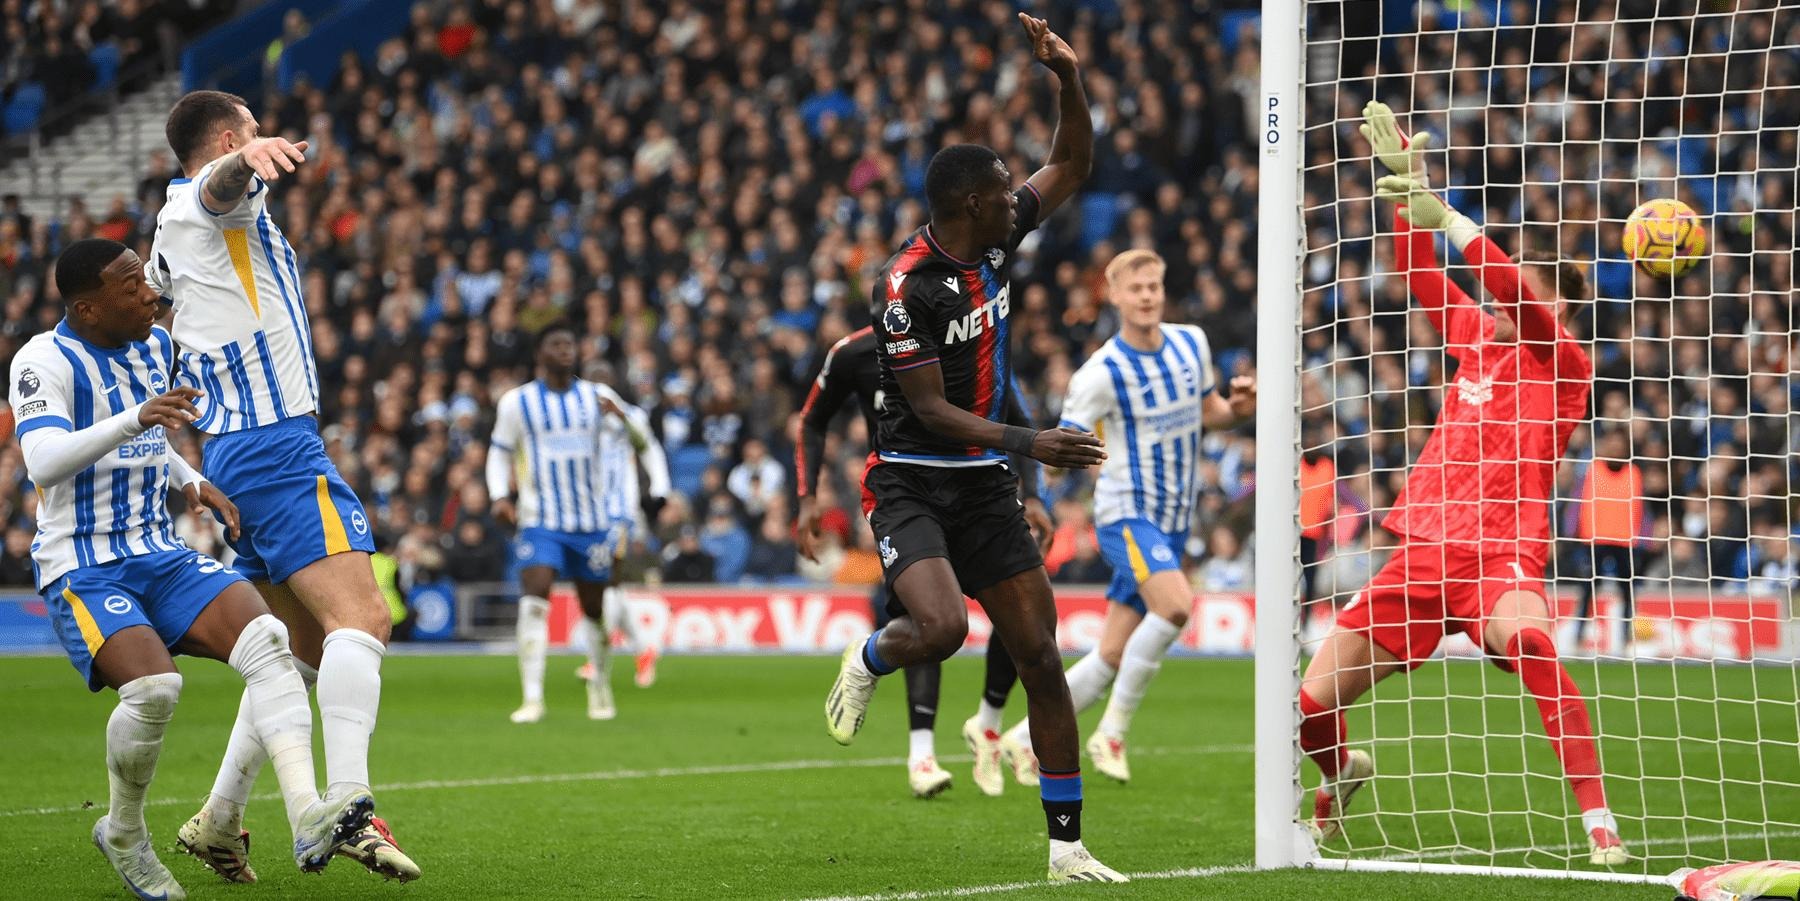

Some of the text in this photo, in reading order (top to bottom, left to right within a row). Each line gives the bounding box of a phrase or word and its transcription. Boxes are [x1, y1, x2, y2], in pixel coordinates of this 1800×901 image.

[1266, 97, 1280, 144] PRO
[945, 280, 1009, 344] NET8
[885, 338, 916, 351] No room
[887, 343, 920, 355] for racism
[119, 442, 166, 458] EXPRE
[1505, 561, 1526, 584] 1
